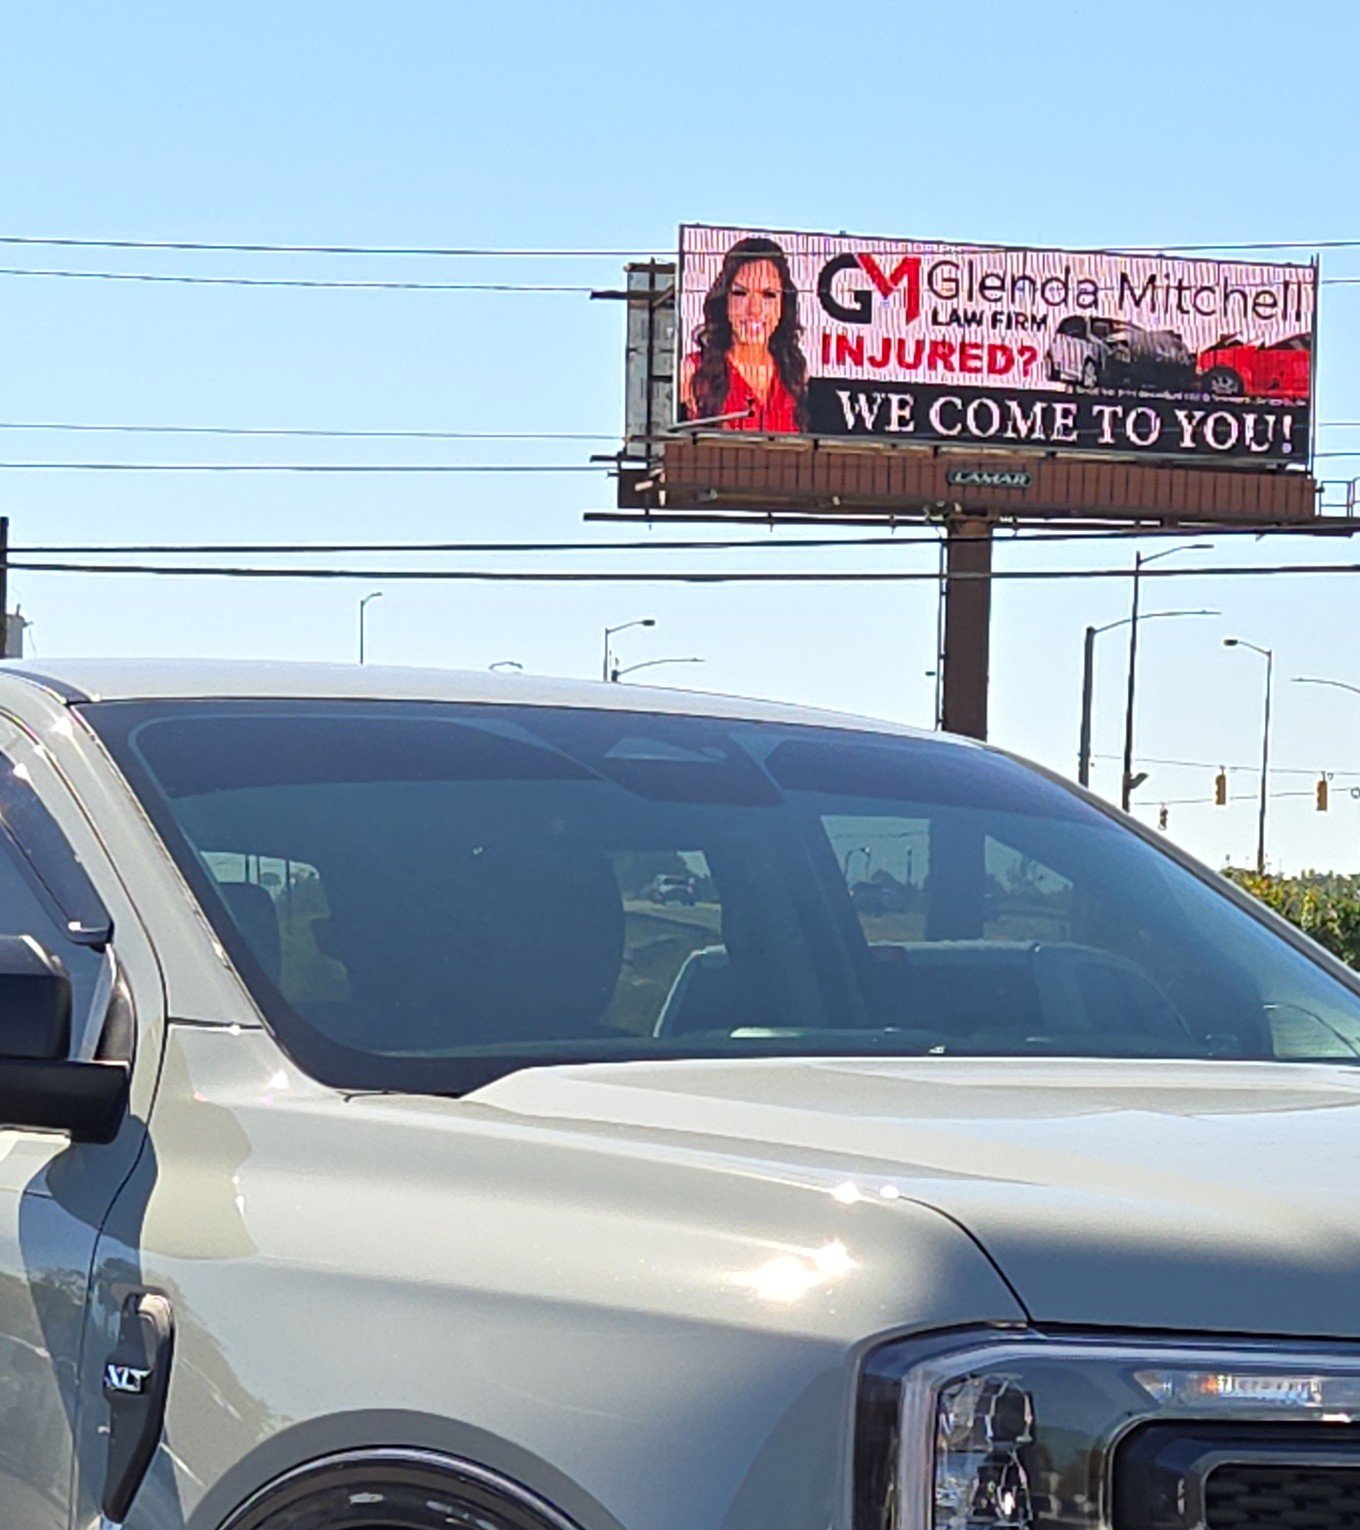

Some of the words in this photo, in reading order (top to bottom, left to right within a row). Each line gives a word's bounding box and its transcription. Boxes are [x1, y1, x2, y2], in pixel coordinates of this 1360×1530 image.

[927, 258, 1099, 310] Glenda
[1118, 271, 1303, 323] Mitchell
[931, 307, 984, 327] LAW
[990, 311, 1048, 332] FIRM
[821, 333, 1038, 377] INJURED?
[835, 390, 916, 433] WE
[928, 396, 1078, 442] COME
[1092, 404, 1162, 447] TO
[1173, 410, 1294, 454] YOU!
